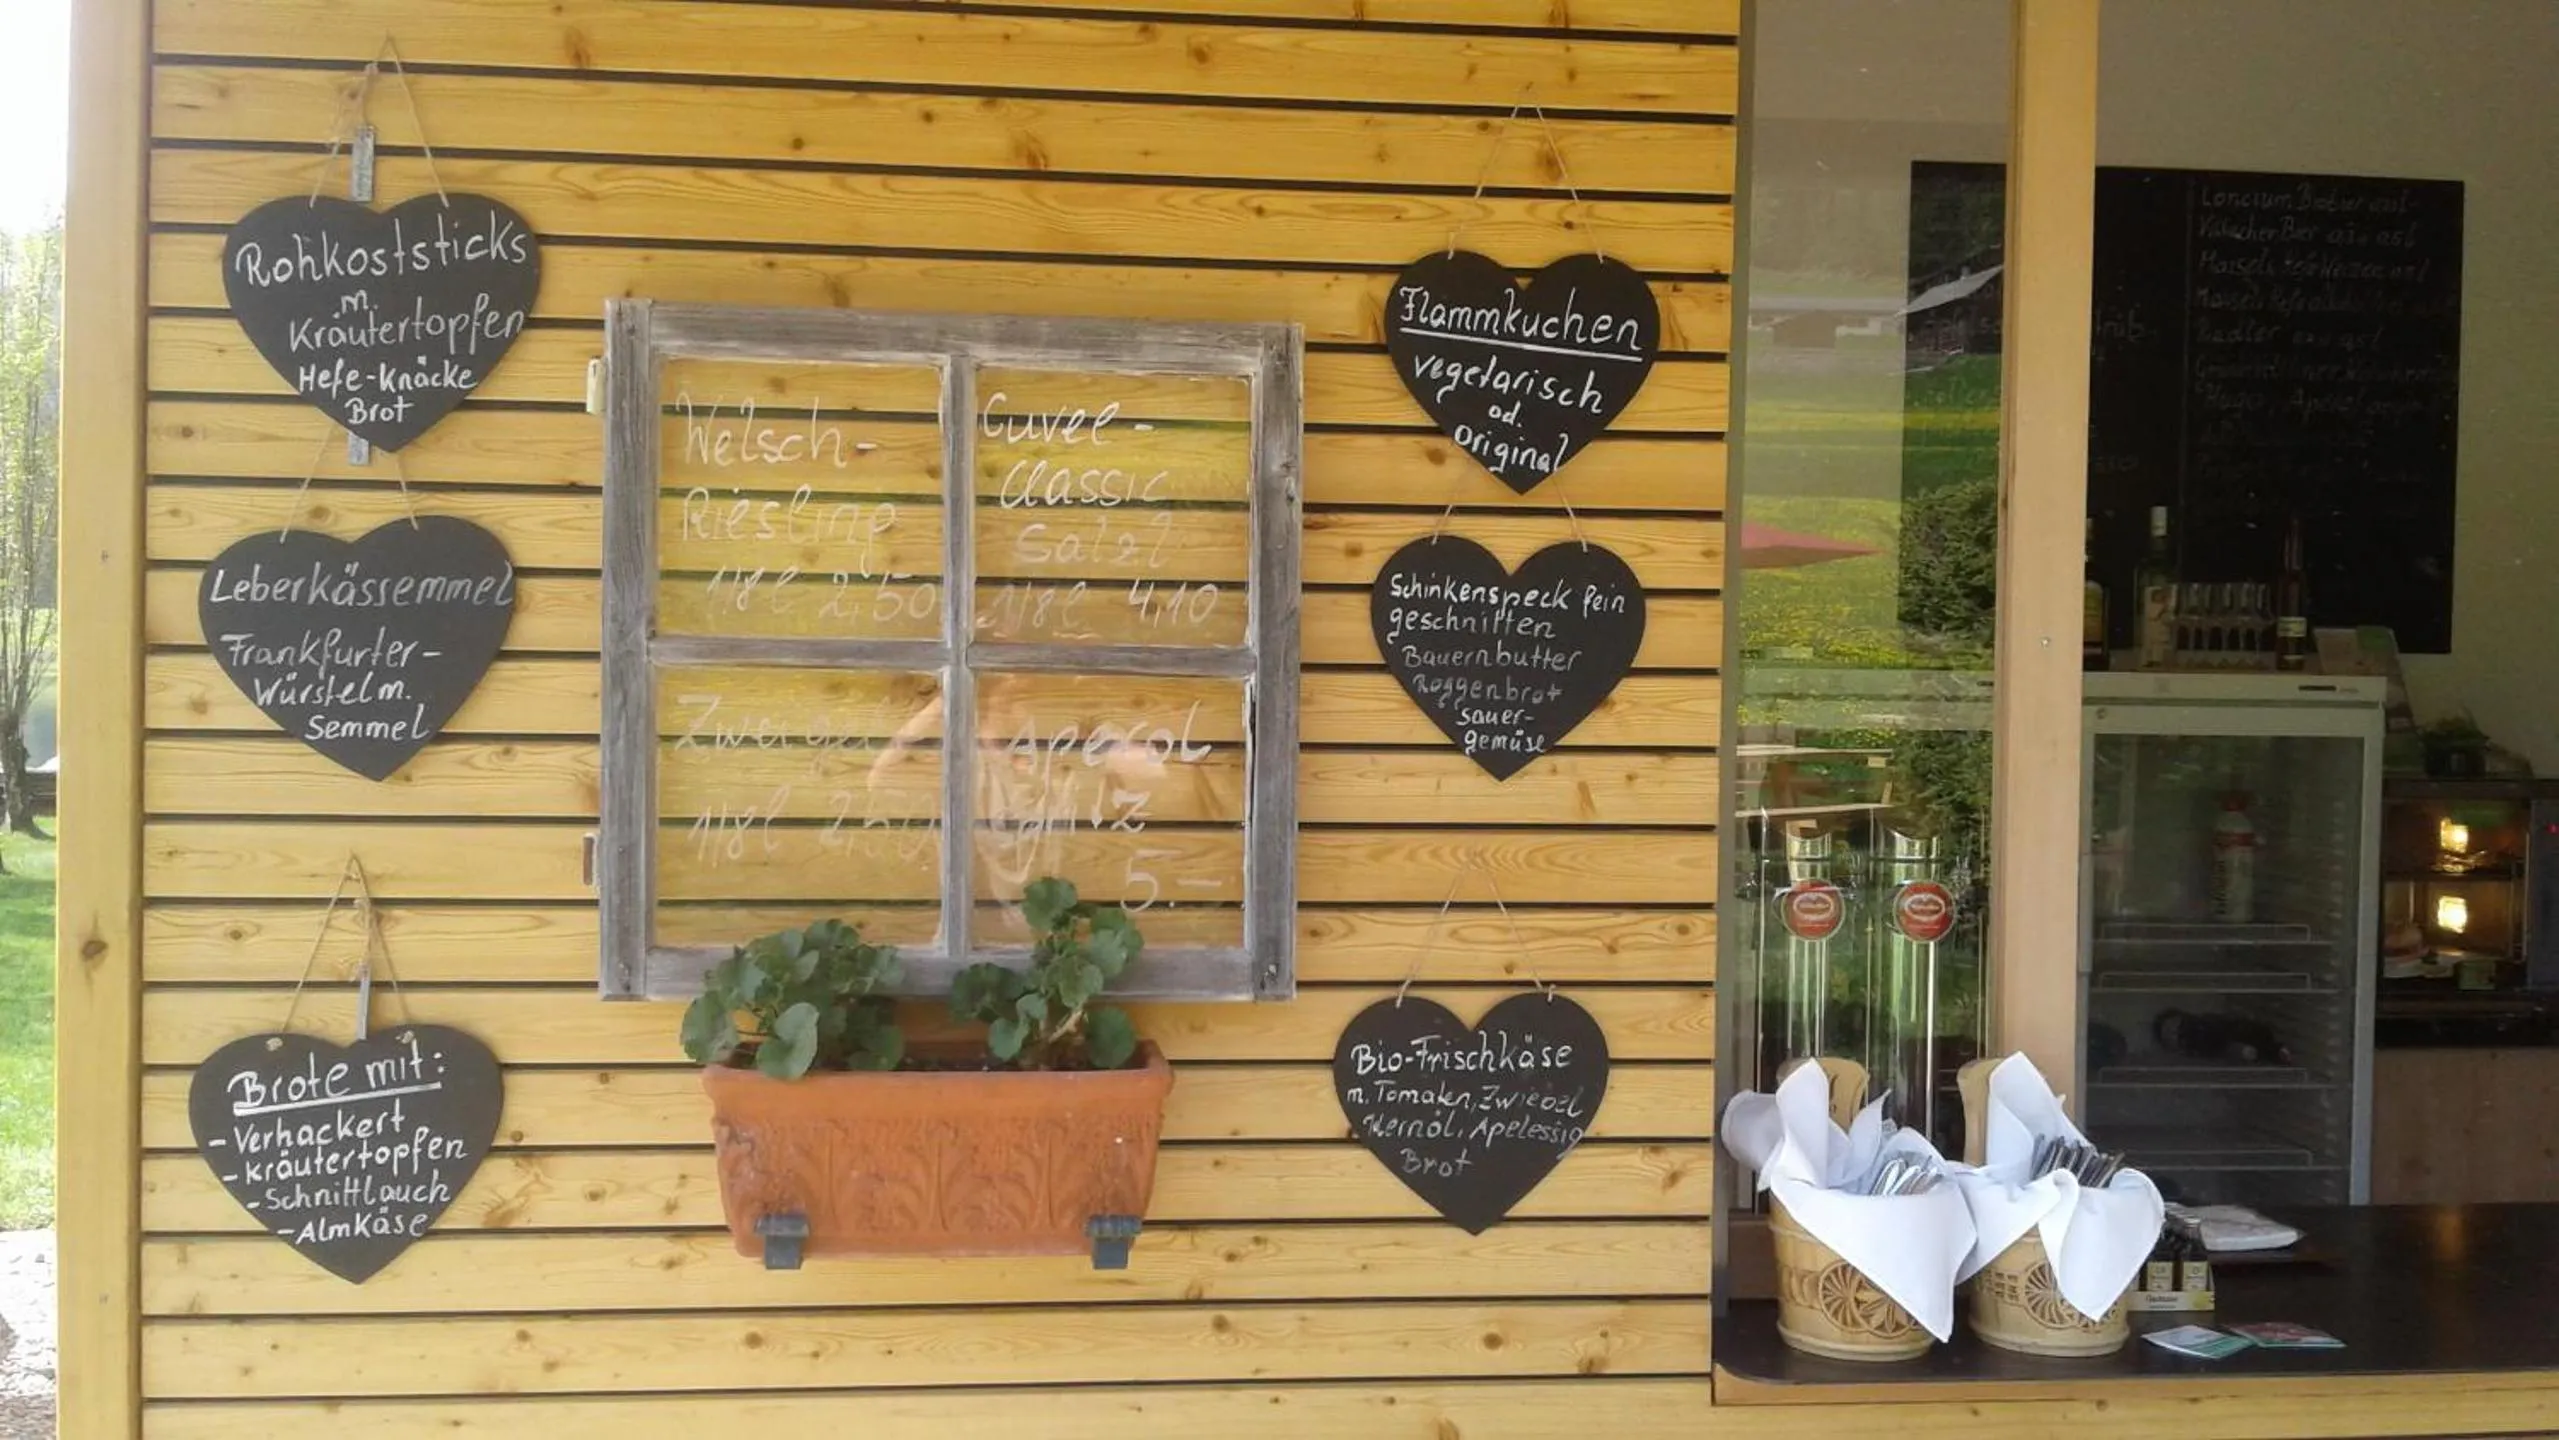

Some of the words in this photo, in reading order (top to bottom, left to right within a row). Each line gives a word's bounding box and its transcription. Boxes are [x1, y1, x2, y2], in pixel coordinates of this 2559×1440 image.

[236, 209, 527, 287] Rohkoststicks
[289, 293, 525, 355] Kräutertopfen
[1400, 287, 1643, 351] Flammkuchen
[344, 396, 414, 425] Brot
[210, 560, 514, 606] Leberkässemmel
[1401, 640, 1583, 671] Bauernbutter
[304, 704, 430, 741] Semmel
[1351, 1030, 1573, 1075] Bio-Frischkäse
[227, 1051, 350, 1108] Brote
[1400, 1148, 1473, 1176] Brot
